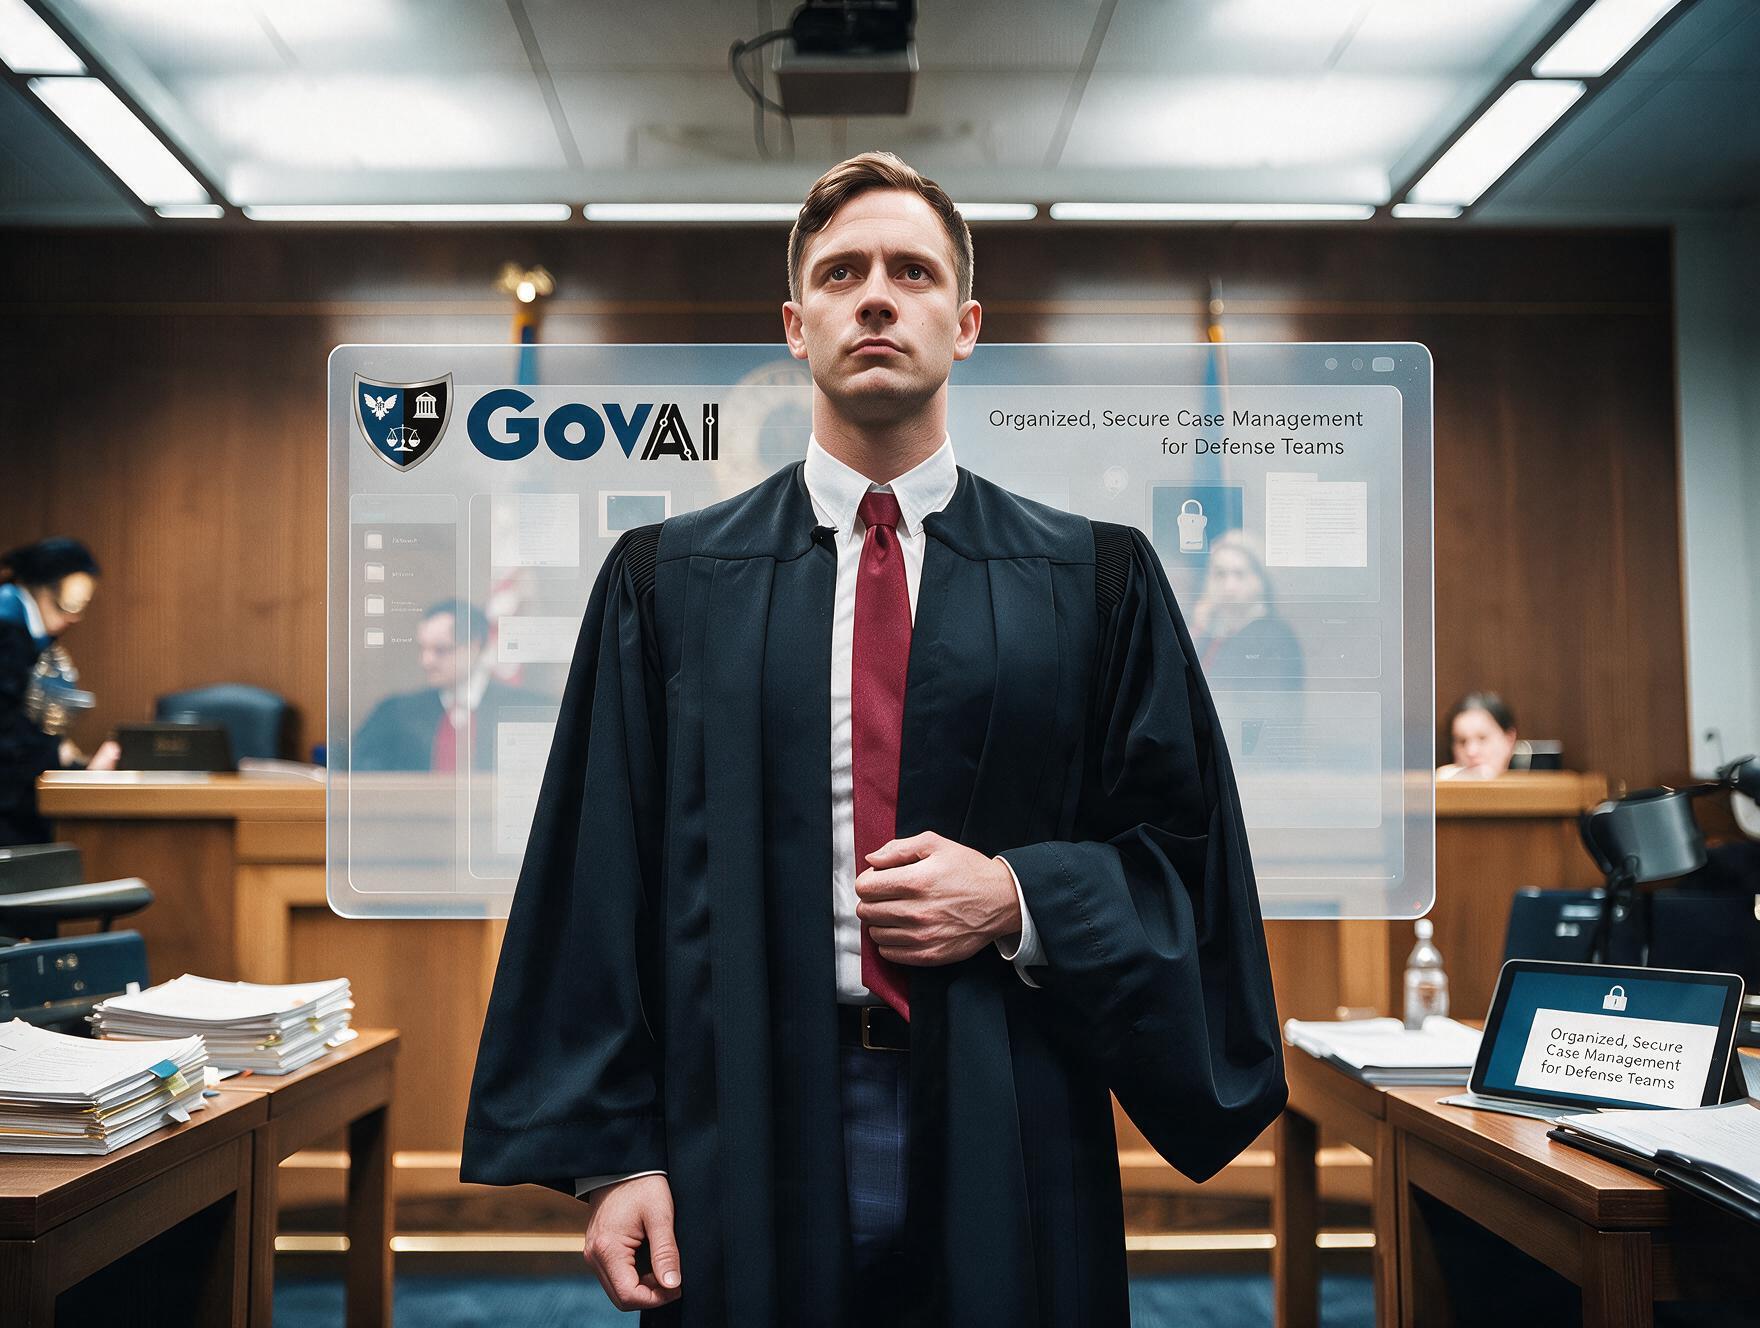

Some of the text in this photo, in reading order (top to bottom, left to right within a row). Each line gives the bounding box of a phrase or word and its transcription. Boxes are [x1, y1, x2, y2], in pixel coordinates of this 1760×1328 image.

[989, 409, 1363, 431] Organized, Secure Case Management
[1161, 437, 1344, 455] for Defense Teams
[1550, 1027, 1683, 1054] Organized, Secure
[1546, 1043, 1682, 1072] Case Management
[1540, 1059, 1675, 1090] for Defense Teams
